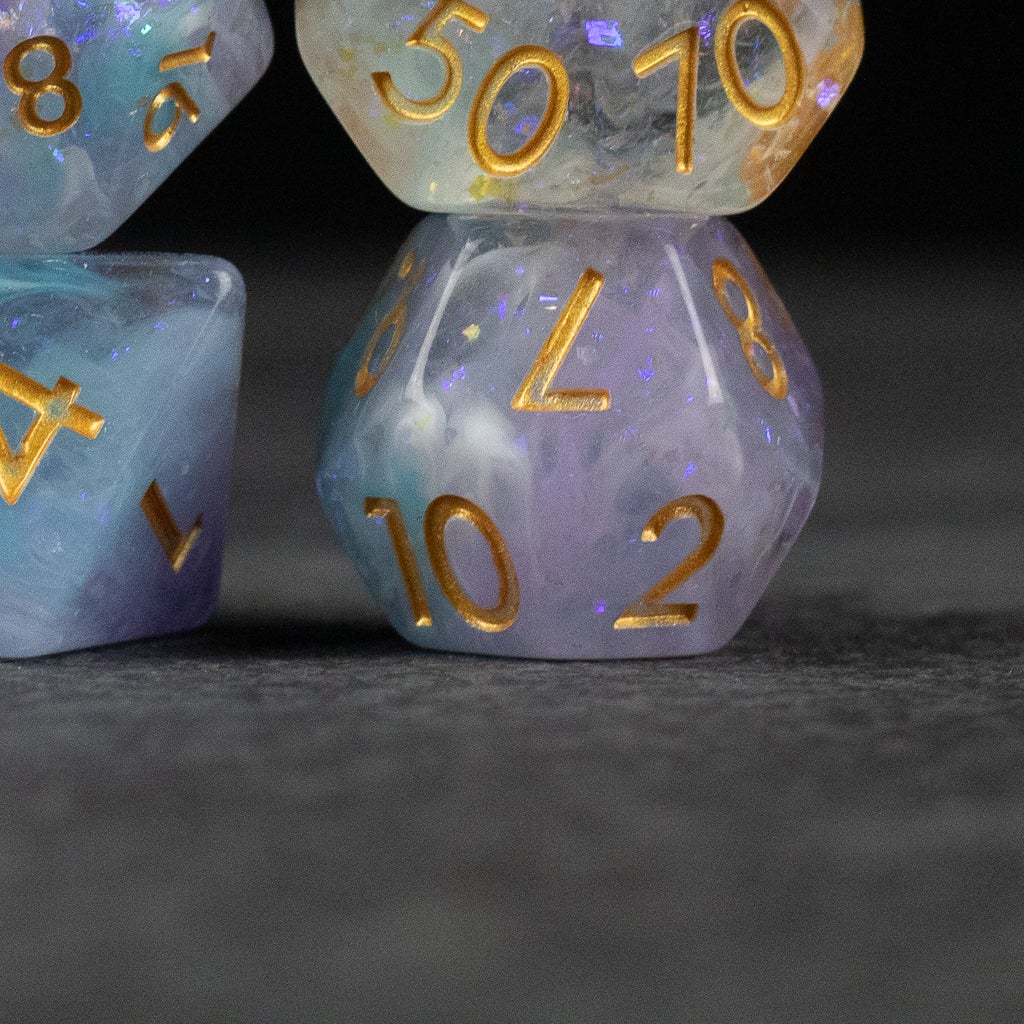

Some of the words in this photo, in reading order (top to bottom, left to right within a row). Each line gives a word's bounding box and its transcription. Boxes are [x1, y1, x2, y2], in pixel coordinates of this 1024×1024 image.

[3, 35, 83, 136] 8
[512, 269, 611, 412] 7
[713, 258, 789, 400] 8
[140, 478, 204, 573] 1
[364, 494, 520, 633] 10
[613, 494, 726, 630] 2
